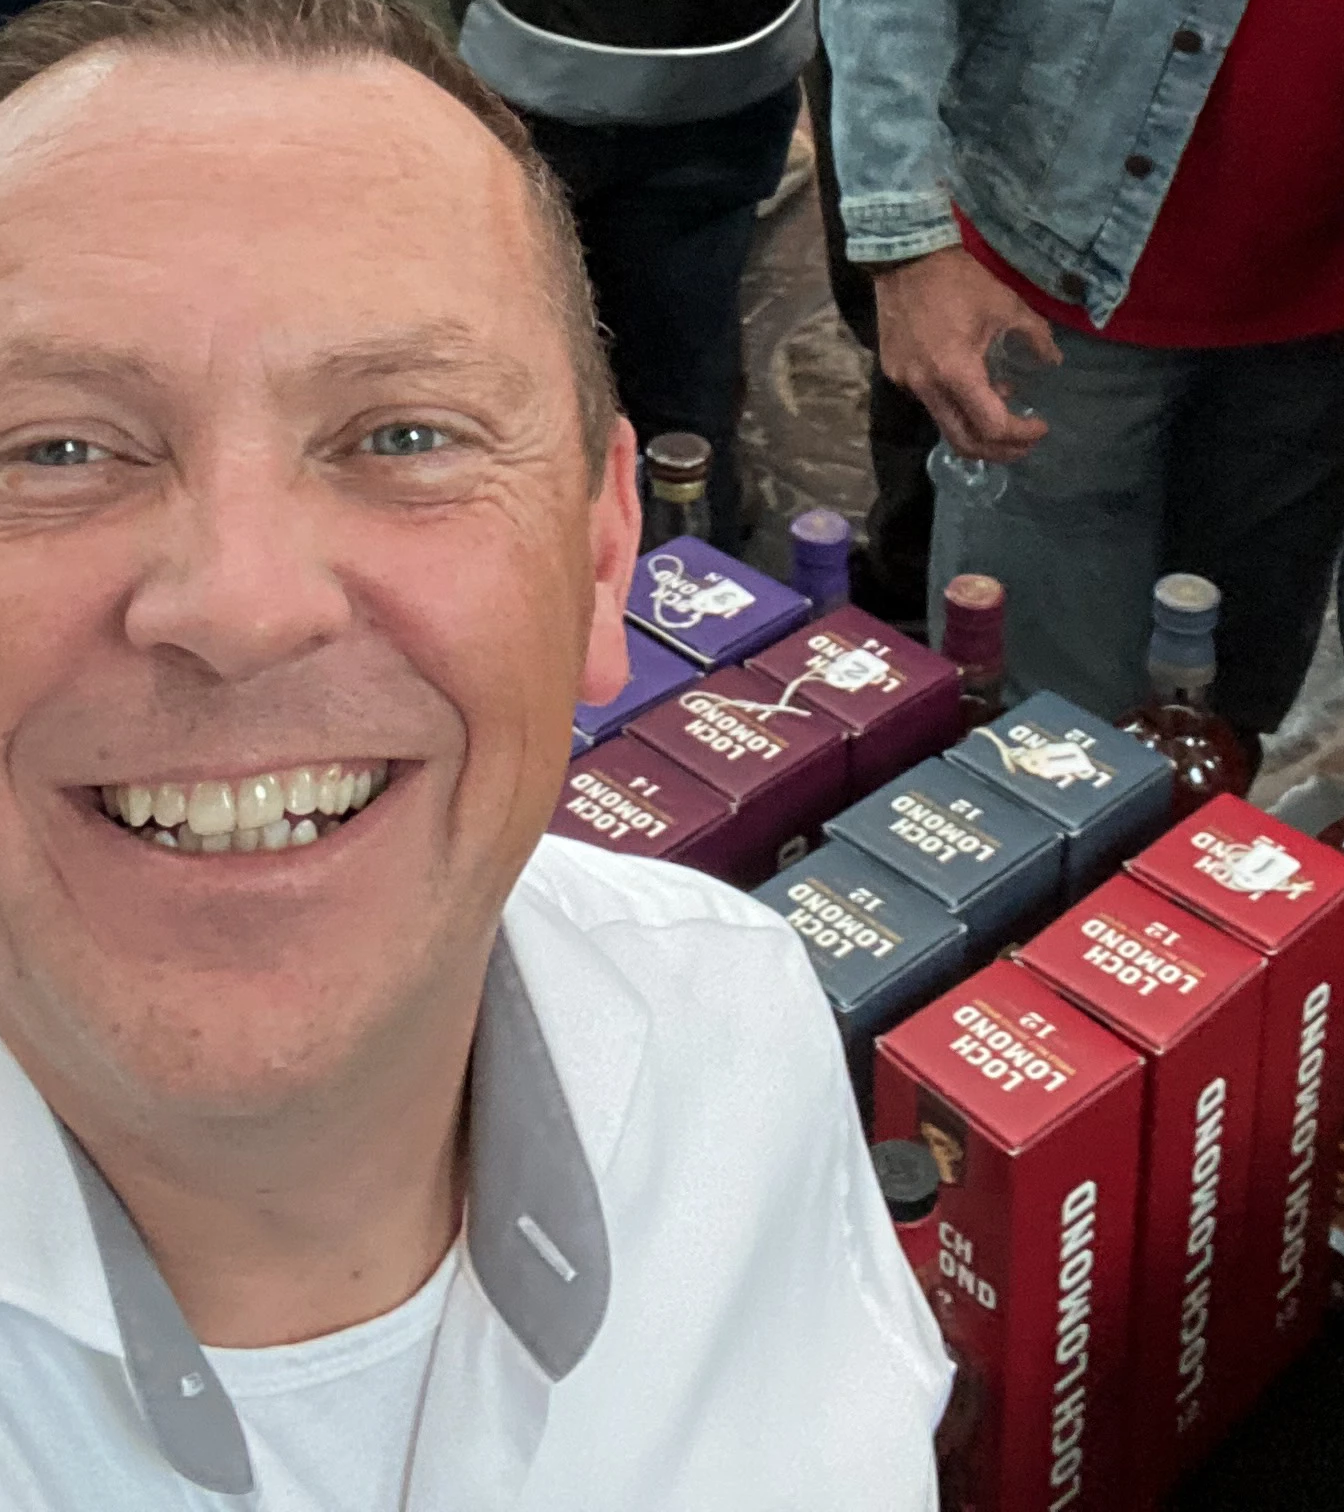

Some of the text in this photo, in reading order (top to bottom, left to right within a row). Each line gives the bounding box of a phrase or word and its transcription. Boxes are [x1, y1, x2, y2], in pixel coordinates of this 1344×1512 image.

[684, 718, 747, 761] LOCH
[688, 697, 783, 761] LOMOND
[1064, 727, 1097, 750] 12
[569, 772, 668, 839] LOMOND
[628, 776, 660, 798] 14
[949, 798, 985, 822] 12
[566, 795, 632, 839] LOCH
[888, 816, 958, 864] LOCH
[890, 795, 997, 863] LOMOND
[787, 883, 895, 959] LOMOND
[848, 887, 886, 913] 12
[784, 908, 855, 960] LOCH
[1080, 918, 1200, 995] LOMOND
[1143, 921, 1182, 947] 12
[1083, 945, 1160, 997] LOCH
[951, 1004, 1068, 1093] LOMOND
[1018, 1011, 1057, 1040] 12
[948, 1034, 1026, 1093] LOCH
[1288, 982, 1332, 1183] LOMOND
[1185, 1076, 1227, 1284] LOMOND
[1276, 1181, 1313, 1301] LOCH
[1049, 1180, 1098, 1512] LOCH LOMOND
[1175, 1278, 1211, 1404] LOCH
